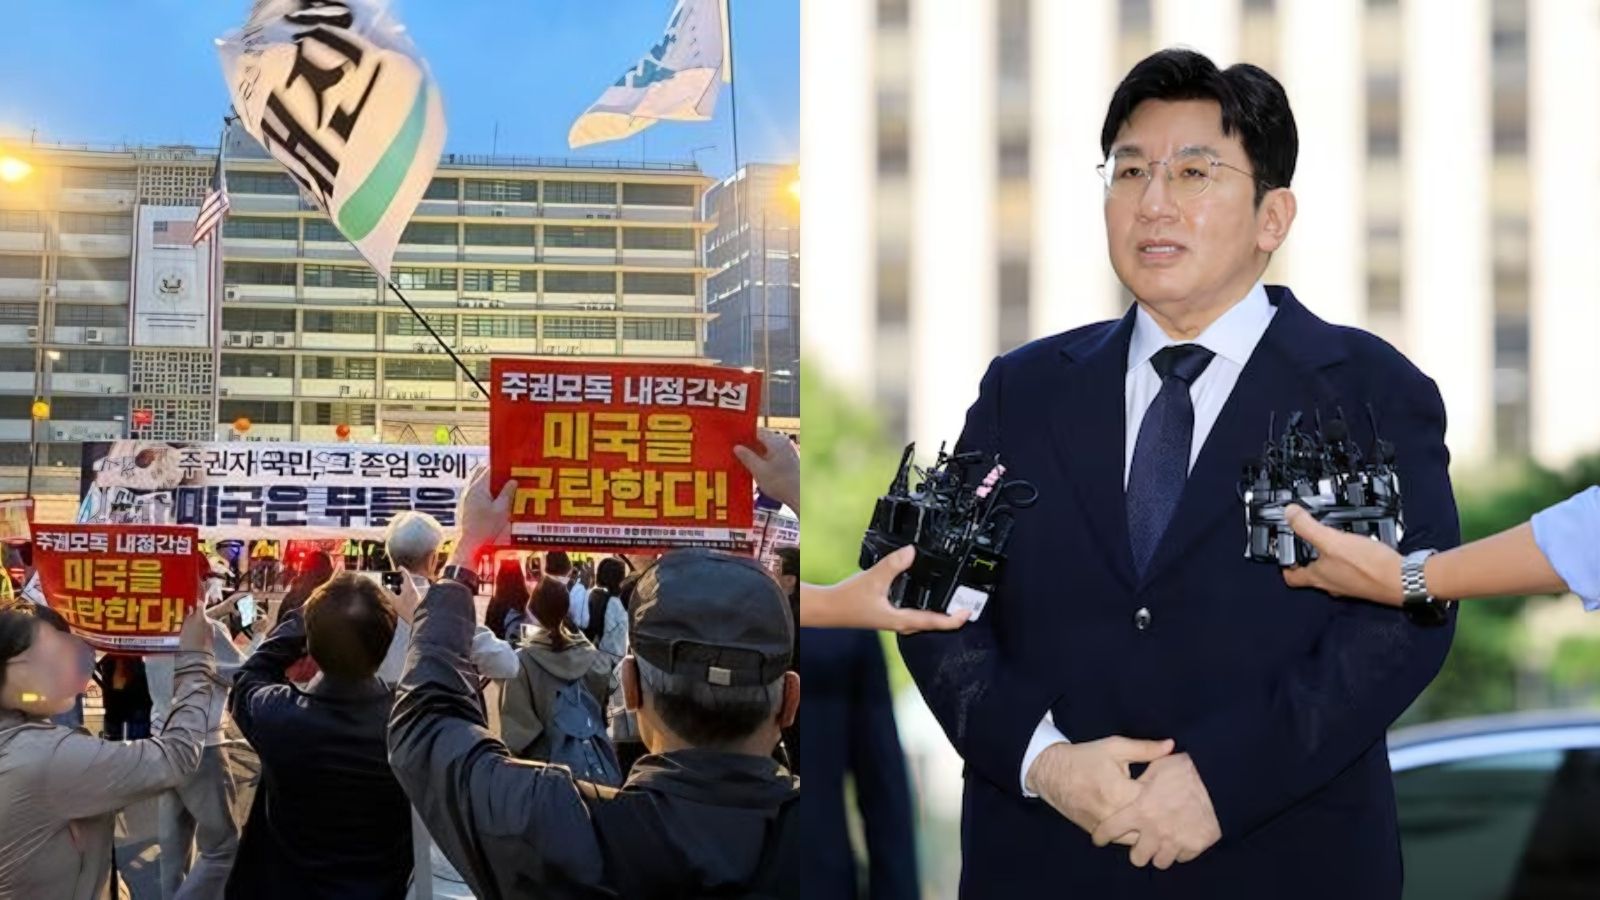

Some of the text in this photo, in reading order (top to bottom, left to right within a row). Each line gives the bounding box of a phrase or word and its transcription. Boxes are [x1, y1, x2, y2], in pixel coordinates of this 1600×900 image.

[501, 372, 748, 411] 주권모독 내정간섭
[543, 412, 693, 463] 미국을
[360, 451, 408, 479] 존엄
[416, 452, 466, 480] 앞에
[177, 485, 308, 527] 미국은
[510, 467, 727, 520] 규탄한다!
[36, 531, 192, 555] 주권모독 내정간섭
[64, 558, 162, 593] 미국을
